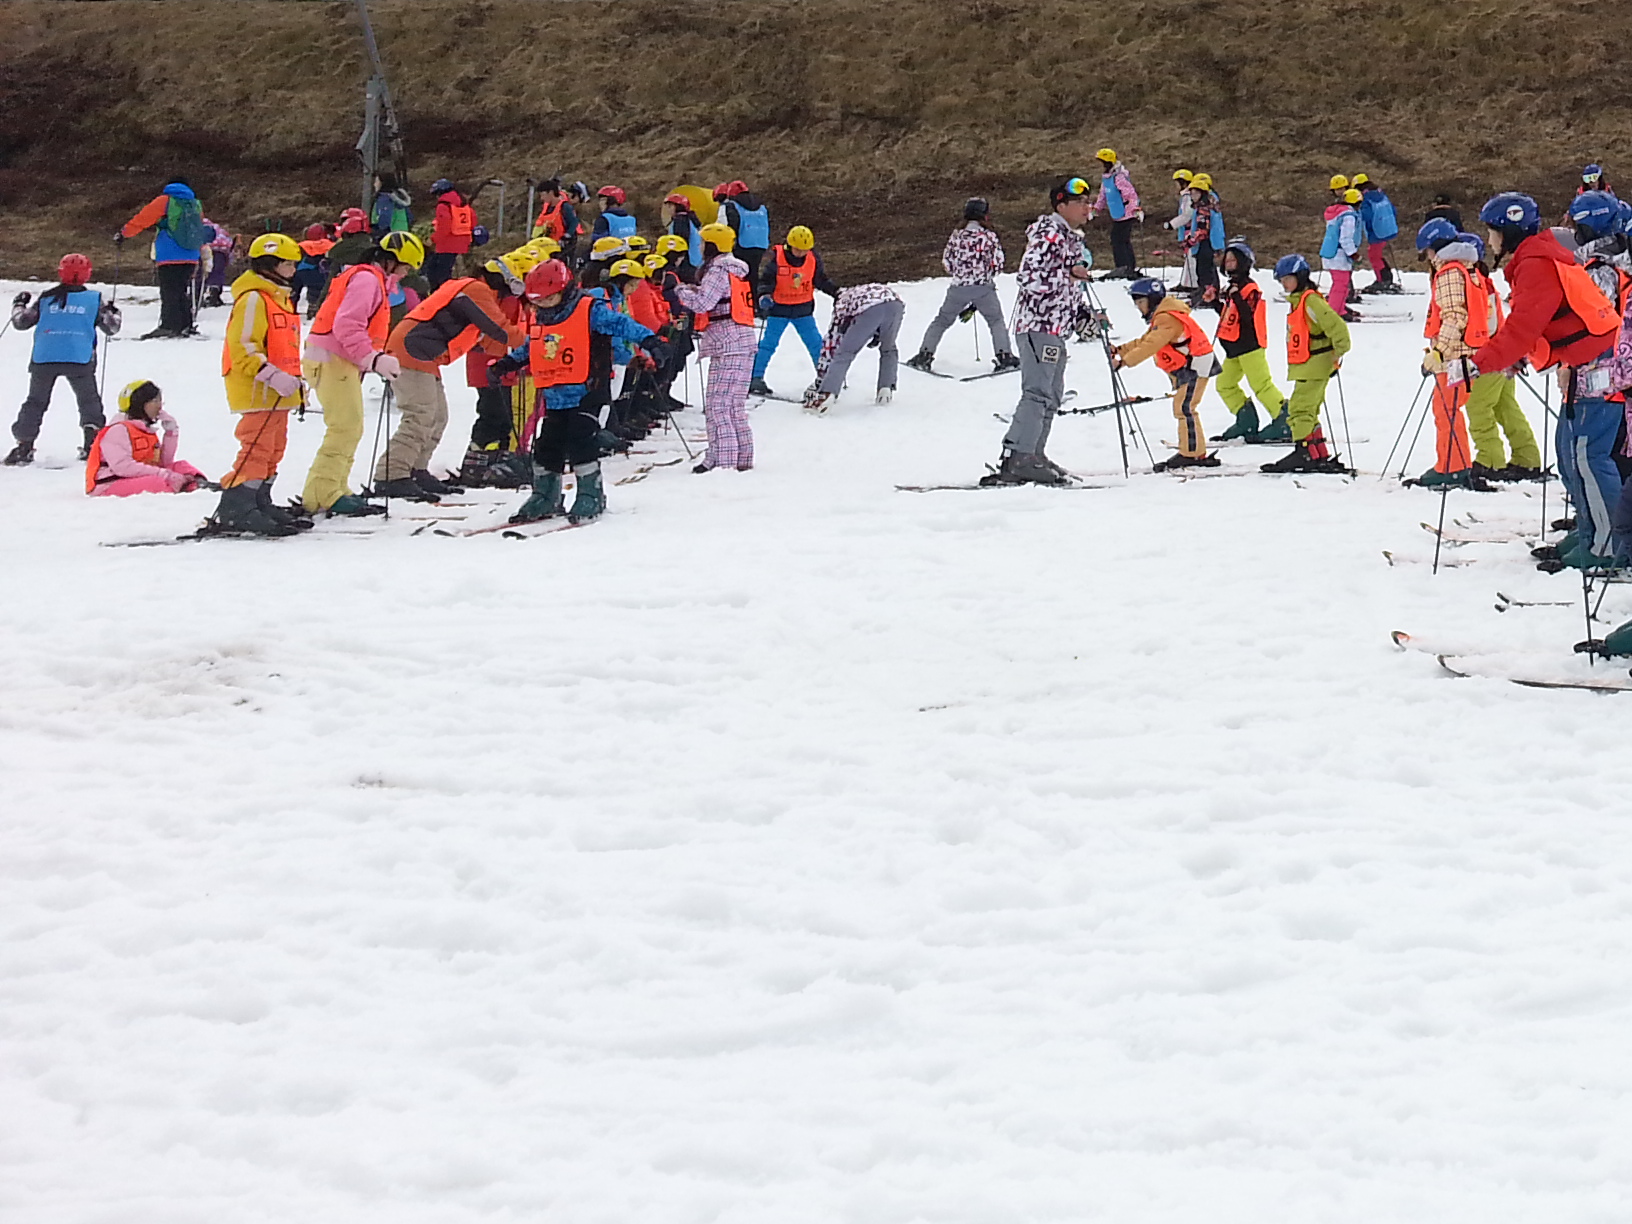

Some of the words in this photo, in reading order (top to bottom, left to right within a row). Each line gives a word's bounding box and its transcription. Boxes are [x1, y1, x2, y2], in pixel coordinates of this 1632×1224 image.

[1228, 313, 1236, 326] 9
[1293, 334, 1300, 348] 9
[561, 347, 574, 365] 6
